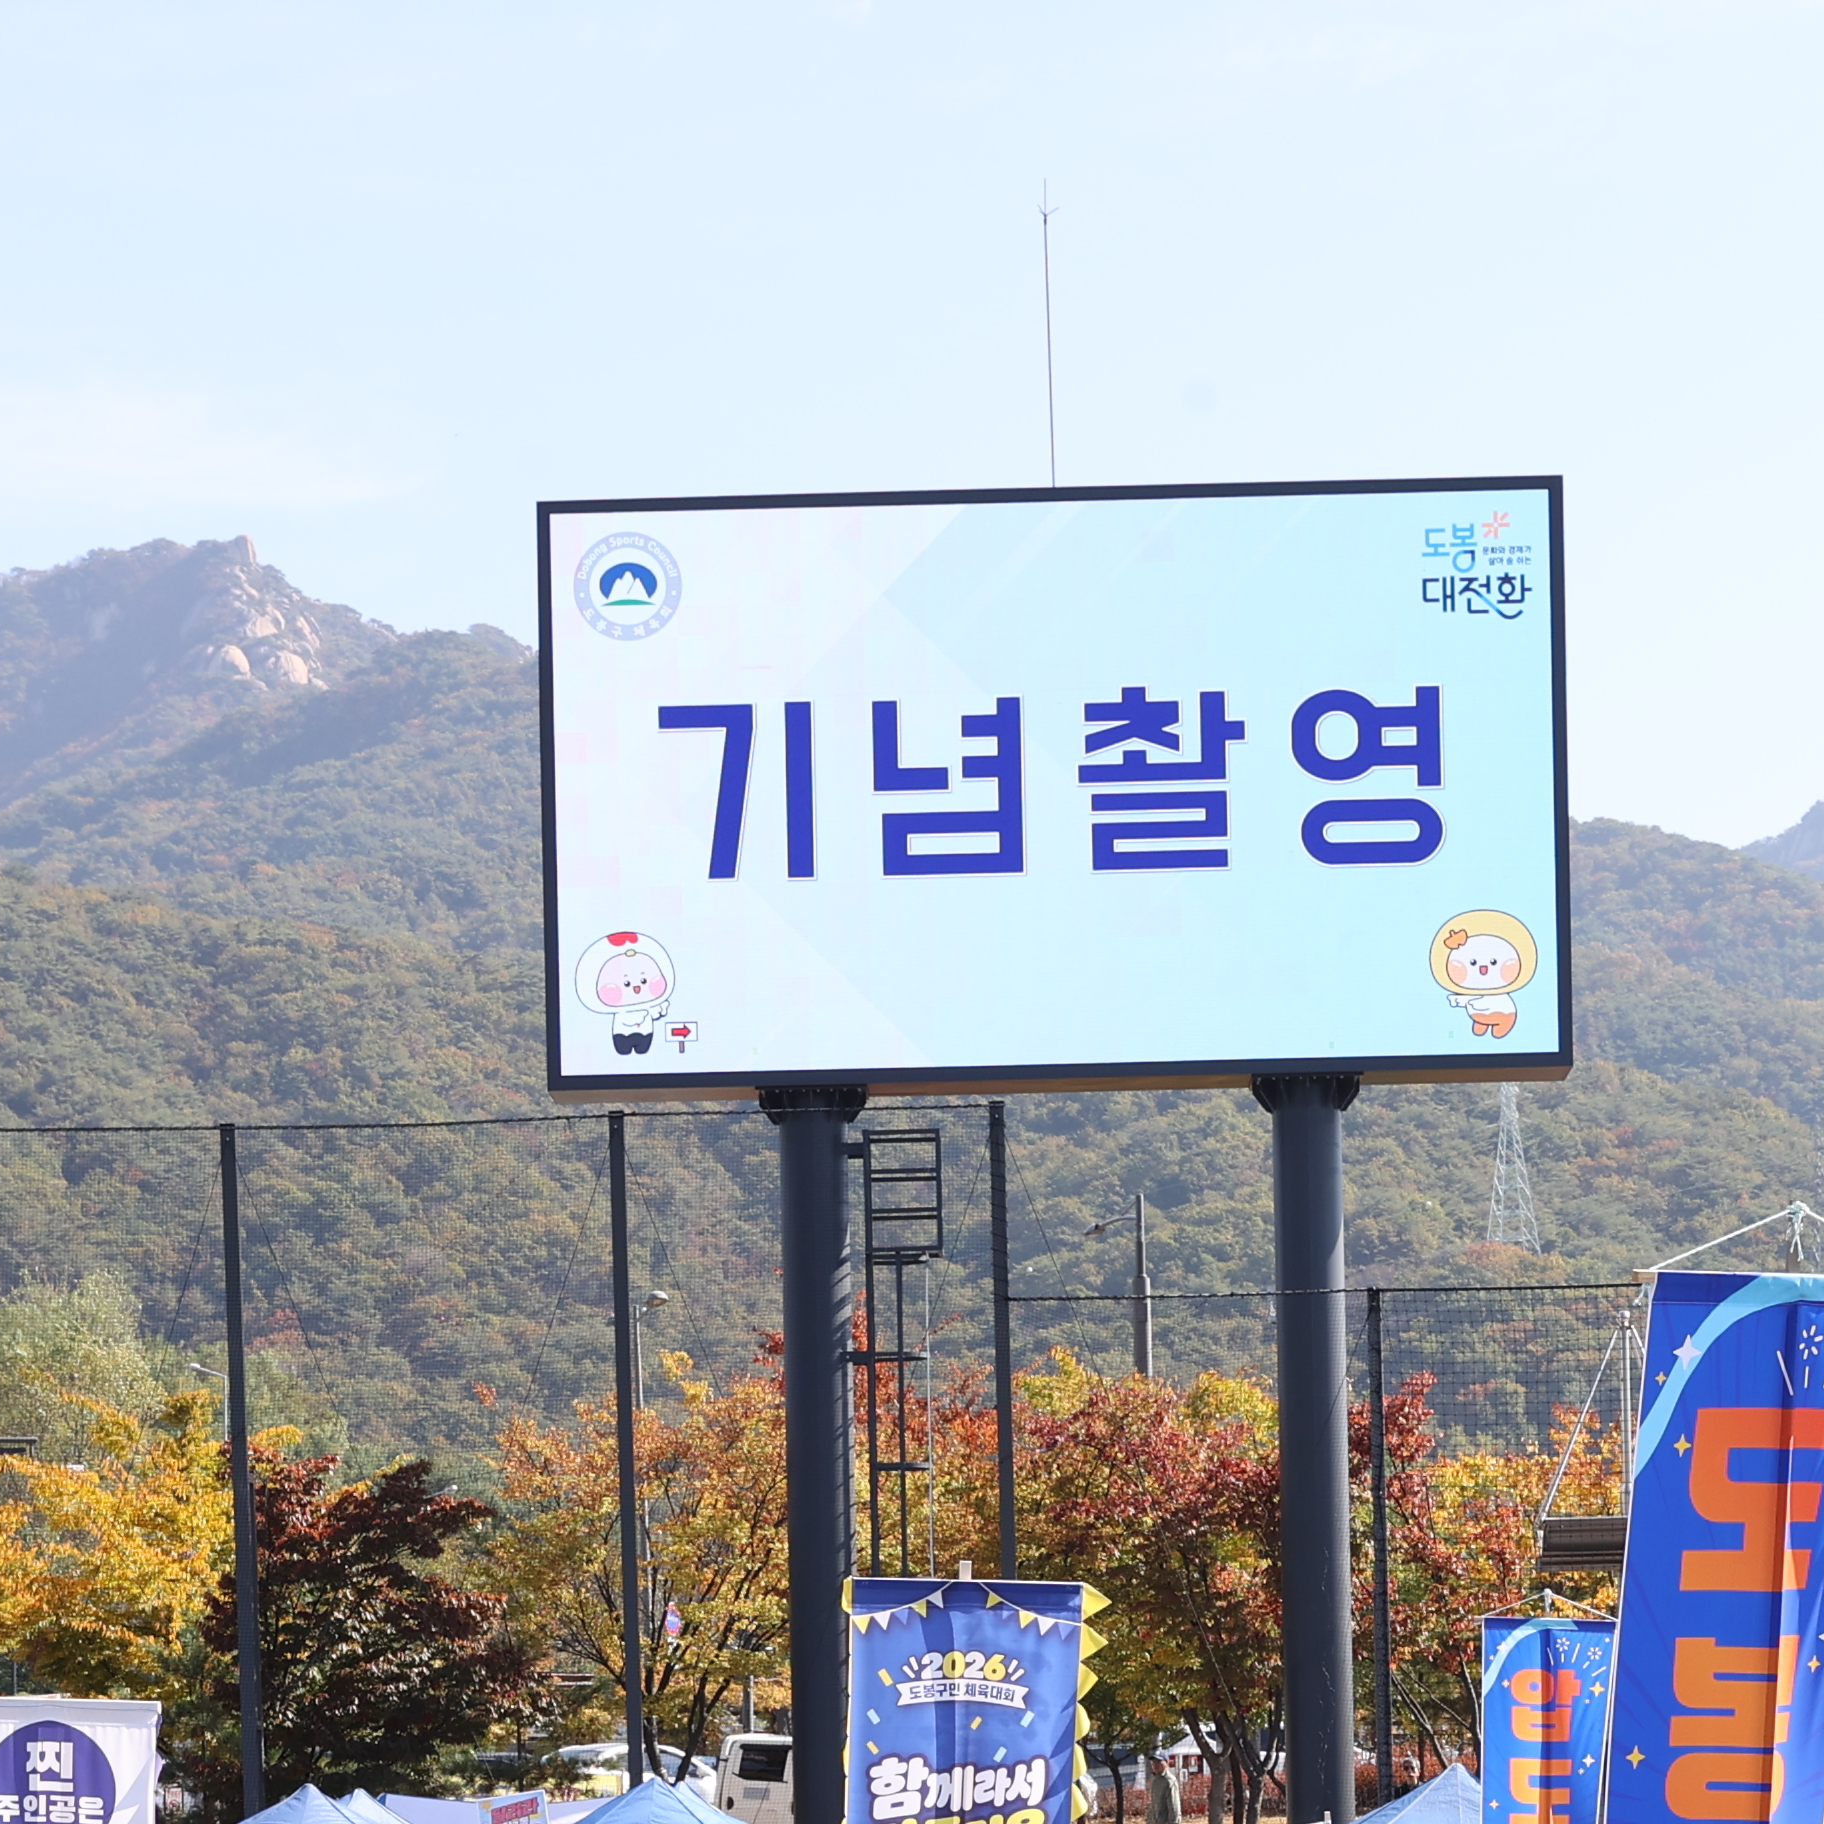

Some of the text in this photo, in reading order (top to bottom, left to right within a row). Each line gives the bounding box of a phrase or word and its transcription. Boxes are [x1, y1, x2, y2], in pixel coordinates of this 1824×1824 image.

[577, 536, 678, 579] Dobong Sports Council
[1422, 523, 1477, 573] 도봉
[1422, 572, 1532, 620] 대전환
[657, 685, 1446, 880] 기념촬영
[920, 1650, 1007, 1681] 2026
[909, 1682, 1016, 1702] 도봉구민 체육대회
[26, 1741, 75, 1791] 찐
[869, 1756, 1046, 1820] 함께라서
